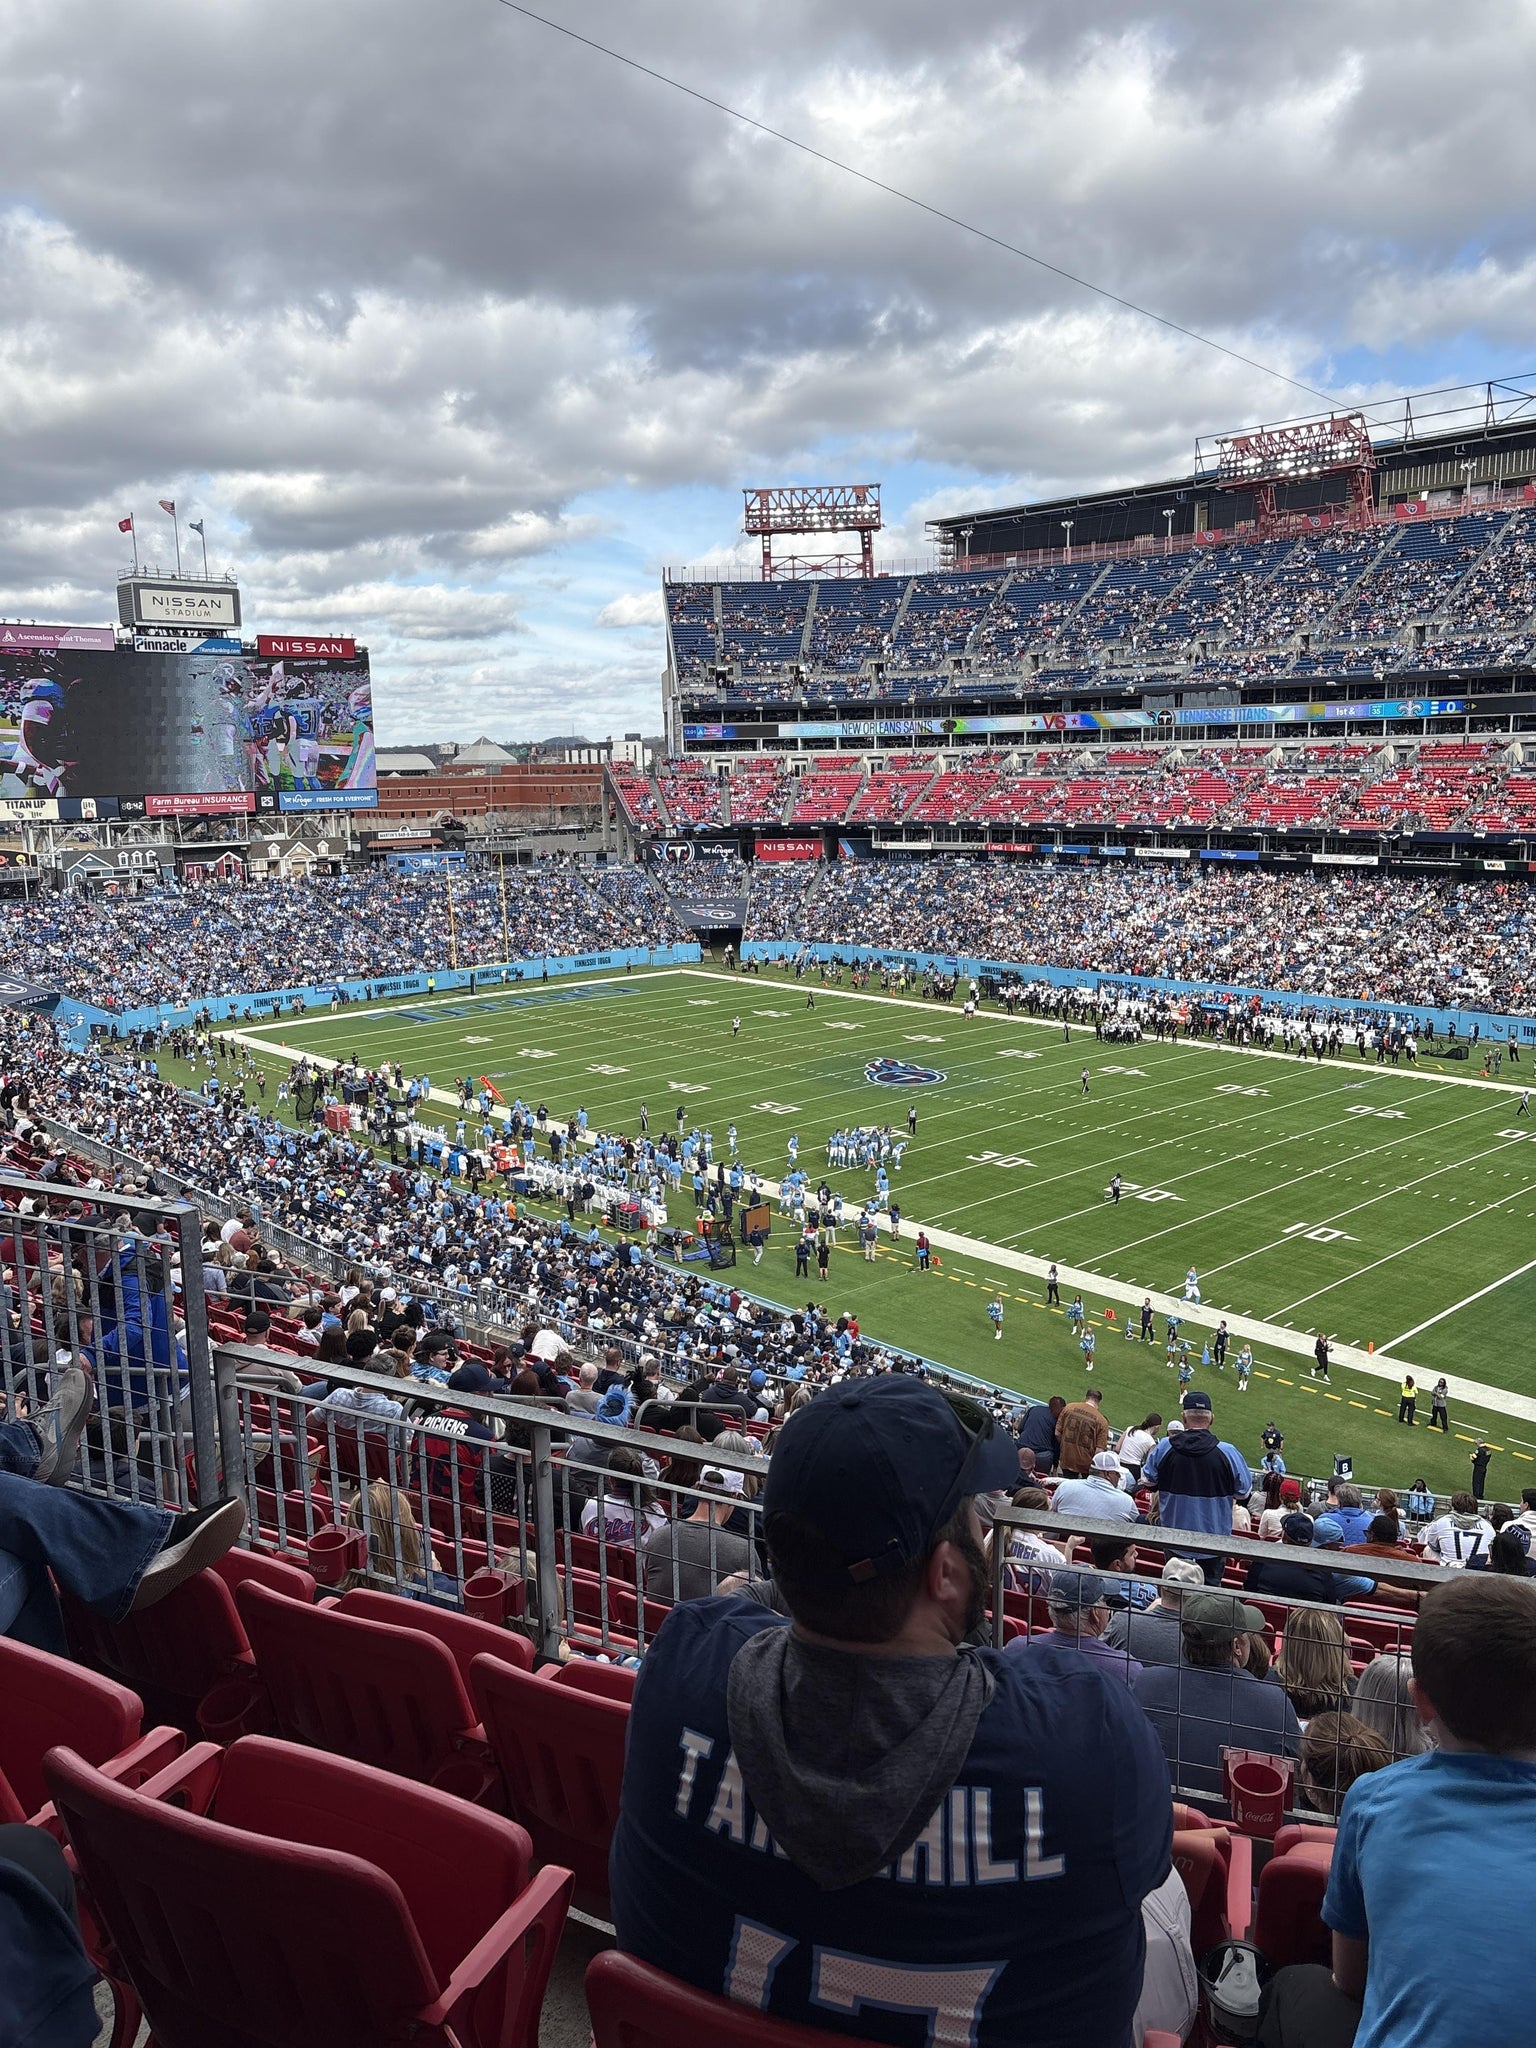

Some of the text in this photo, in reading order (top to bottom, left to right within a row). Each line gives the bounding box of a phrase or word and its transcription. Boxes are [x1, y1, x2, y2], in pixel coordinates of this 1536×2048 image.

[152, 596, 222, 609] NISSAN
[165, 608, 212, 617] STADIUM
[17, 633, 102, 644] Ascension Saint Thomas
[136, 637, 187, 652] Pinnacle
[272, 641, 343, 654] NISSAN
[1336, 707, 1357, 716] 1st &
[1447, 702, 1456, 713] 0
[1179, 707, 1268, 722] TENNESSEE TITANS
[842, 718, 934, 735] NEW ORLEANS SAINTS
[1043, 715, 1067, 729] VS
[5, 801, 31, 810] TITAN
[82, 801, 95, 810] Lite
[174, 798, 200, 806] Bureau
[202, 796, 249, 804] INSURANCE
[292, 796, 313, 806] Kroger
[711, 845, 735, 857] Kroger
[763, 843, 814, 852] NISSAN
[574, 957, 612, 968] TENNESSEE TOUGH
[20, 994, 49, 1005] NISSAN
[1213, 1084, 1270, 1097] 30
[750, 1101, 803, 1115] 50
[1344, 1104, 1406, 1120] 20
[965, 1150, 1031, 1168] 30
[1282, 1221, 1347, 1243] 10
[1105, 1309, 1115, 1319] 10
[423, 1415, 470, 1436] PICKENS
[1341, 1462, 1350, 1473] B
[1450, 1520, 1484, 1531] TAILL
[1010, 1540, 1041, 1561] ORGE
[1453, 1530, 1484, 1562] 17
[673, 1727, 1066, 1887] TAHILL
[724, 1913, 1009, 2048] 17
